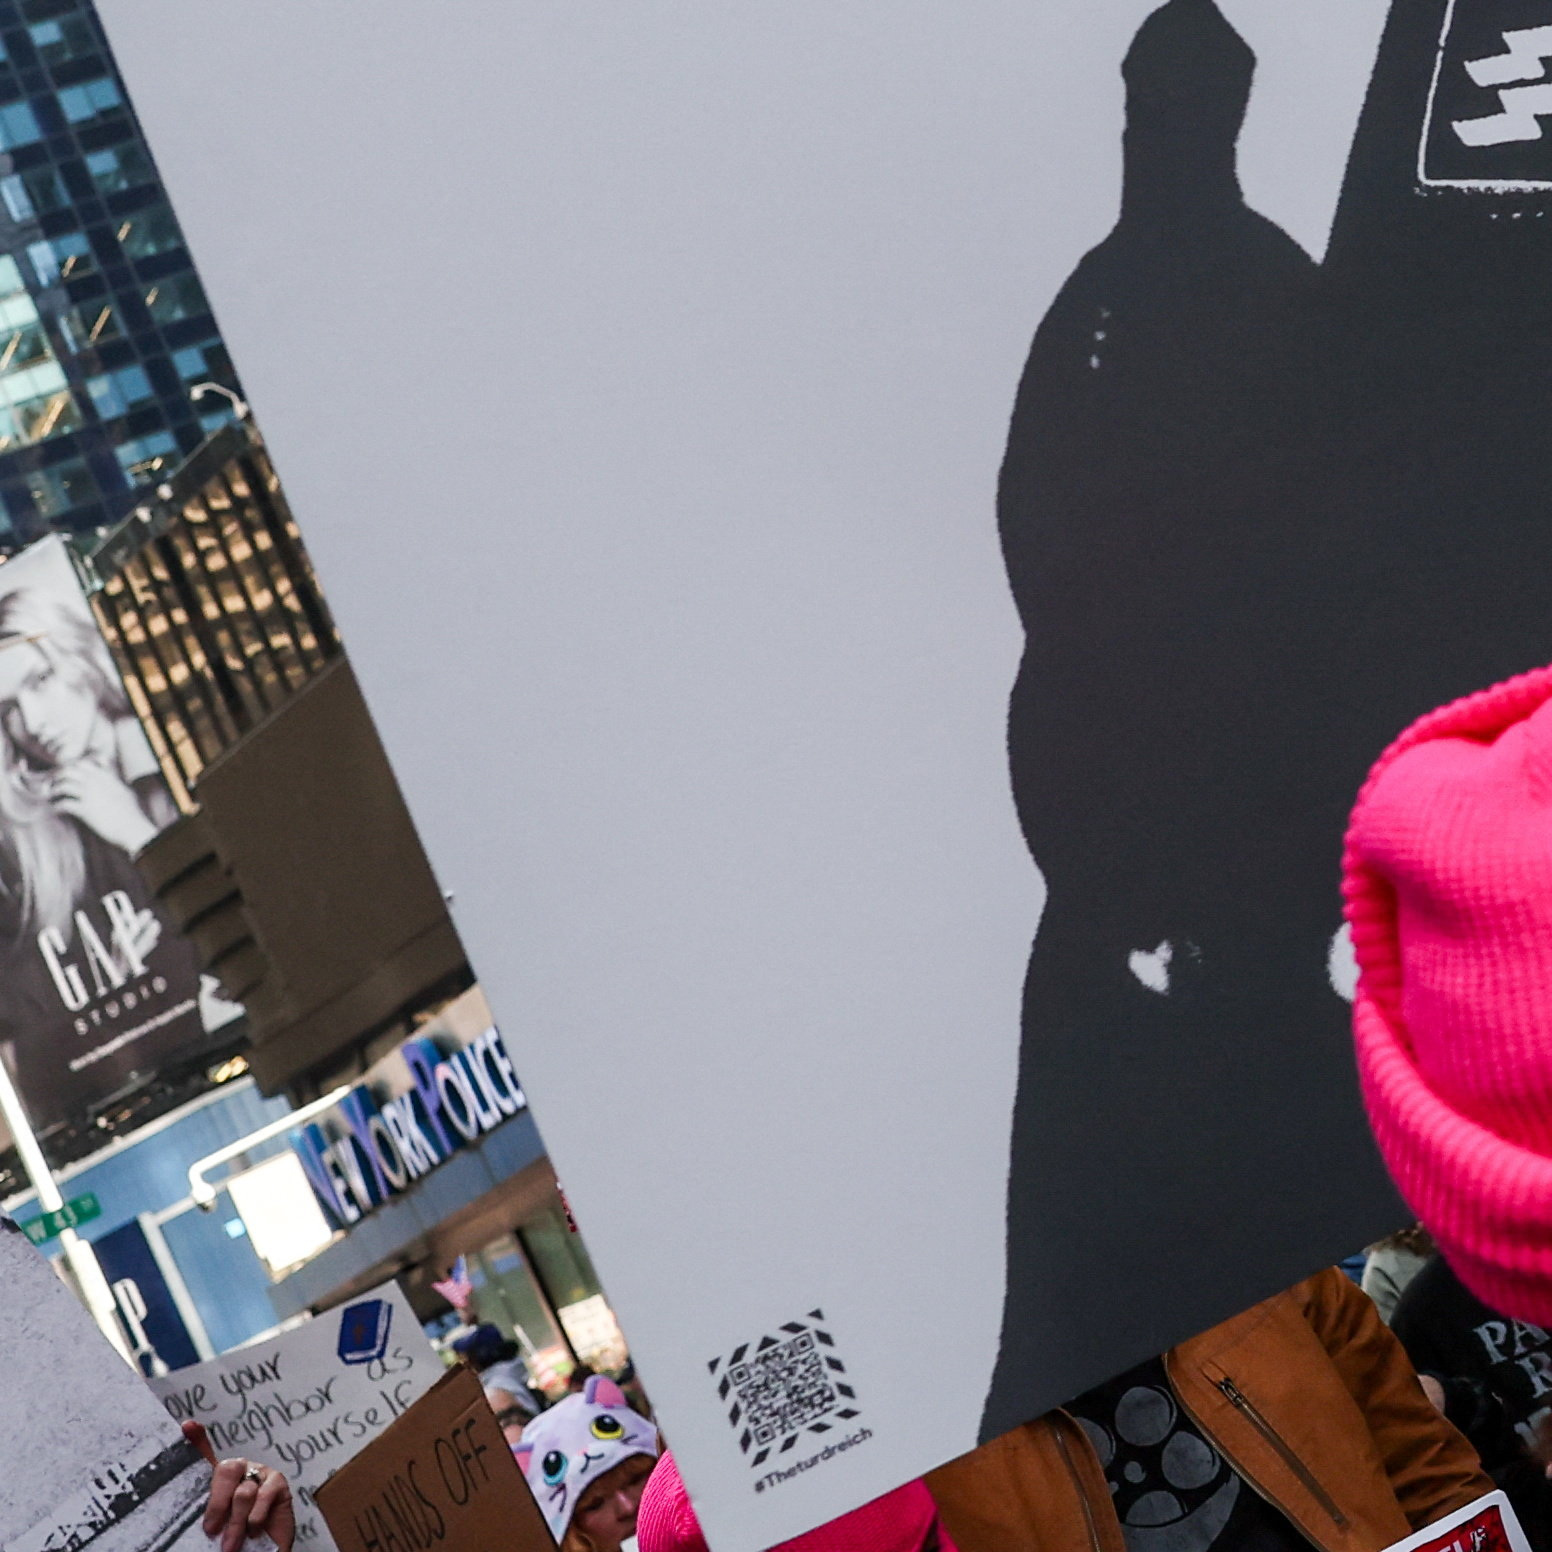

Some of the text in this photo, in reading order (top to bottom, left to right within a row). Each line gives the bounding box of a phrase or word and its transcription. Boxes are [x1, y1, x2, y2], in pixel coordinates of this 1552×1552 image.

[38, 890, 149, 1011] GAP
[73, 975, 168, 1036] STUDIO
[206, 1347, 414, 1459] neighbor as
[219, 1352, 283, 1414] your
[275, 1378, 413, 1480] yourself
[355, 1459, 446, 1552] HANDS
[434, 1417, 489, 1506] OFF
[754, 1427, 873, 1494] #Theturdreich
